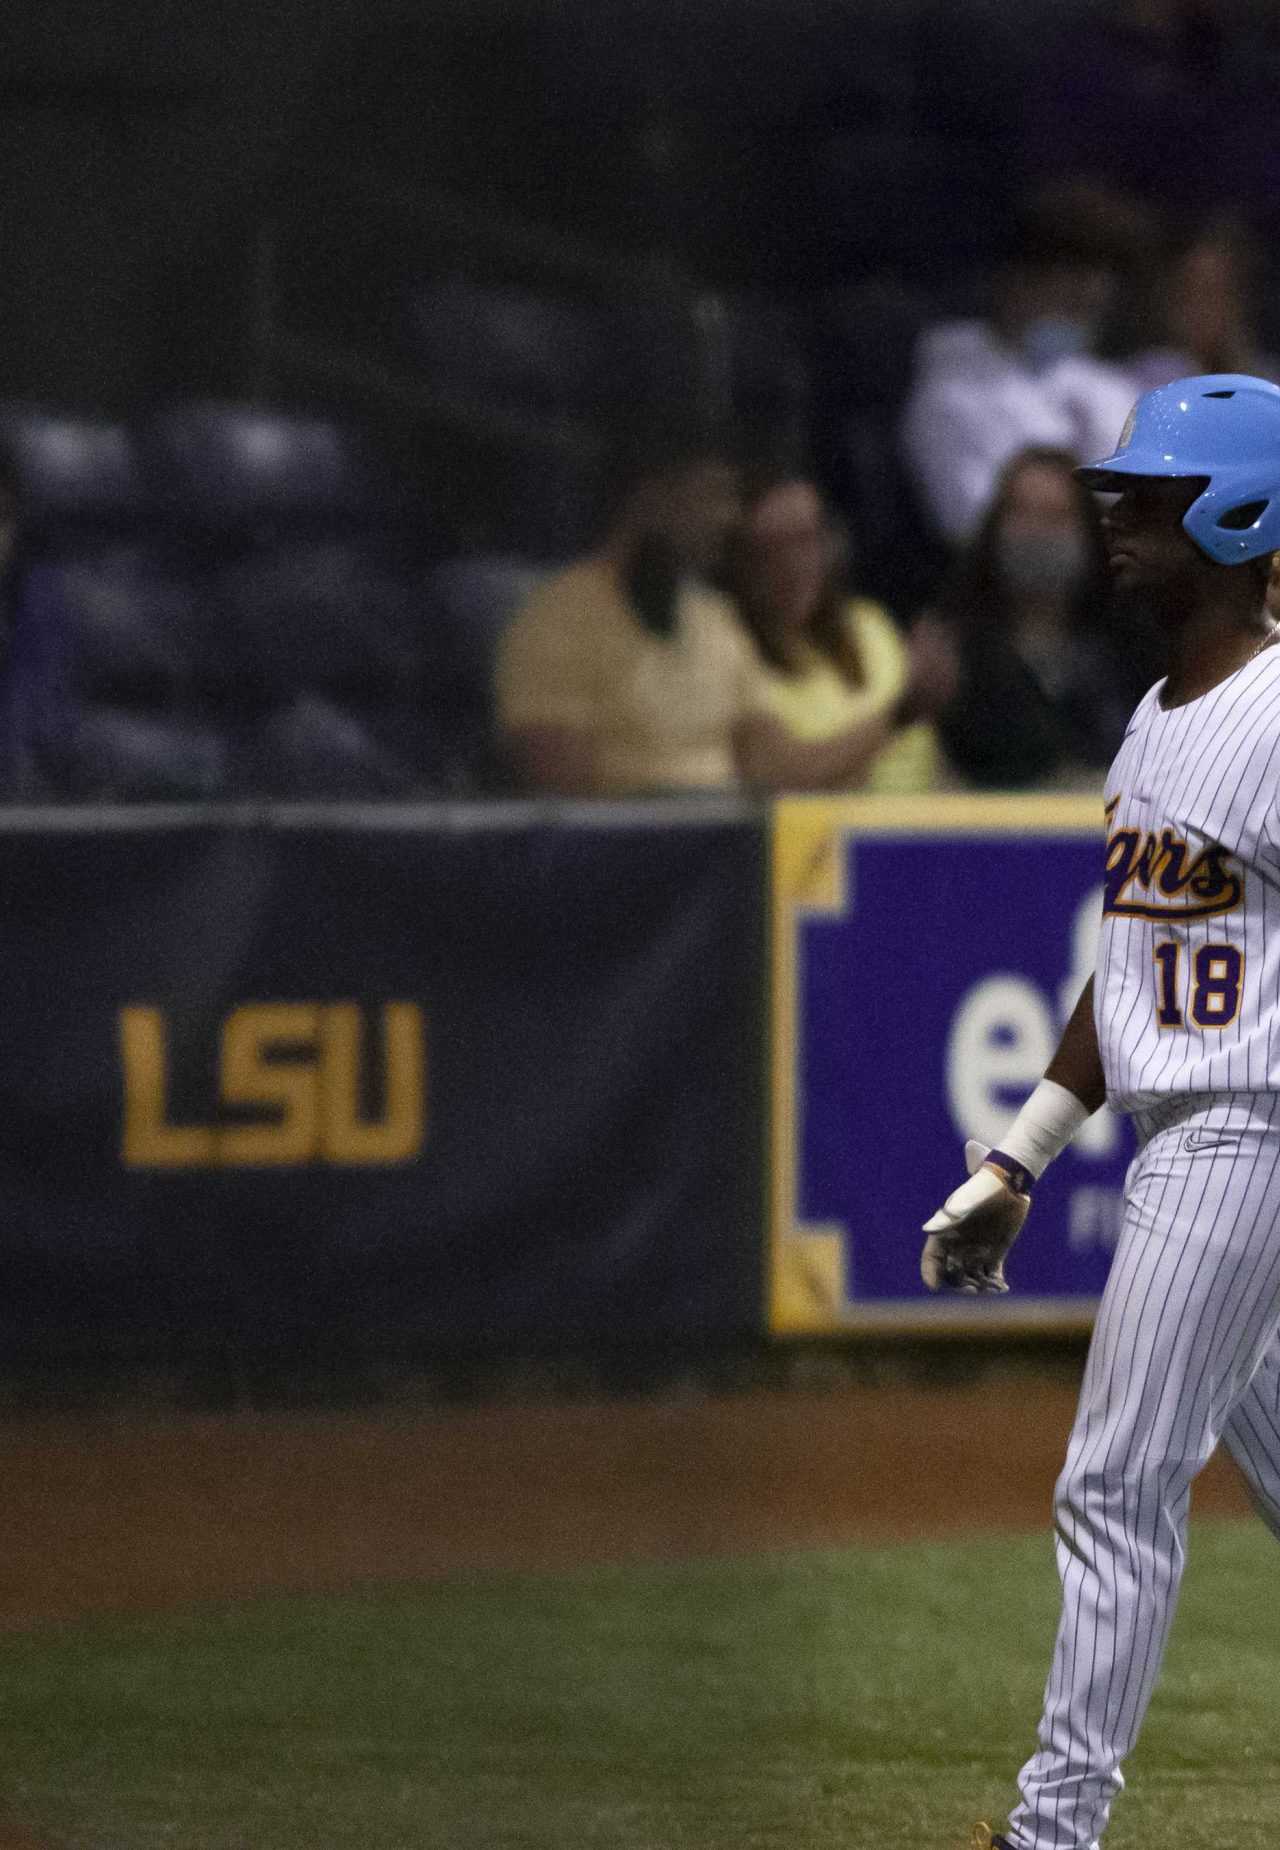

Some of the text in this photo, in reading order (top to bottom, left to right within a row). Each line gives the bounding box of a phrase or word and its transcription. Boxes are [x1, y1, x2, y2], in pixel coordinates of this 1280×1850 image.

[1103, 798, 1246, 923] gers
[1153, 941, 1243, 1029] 18
[120, 1001, 426, 1168] LSU
